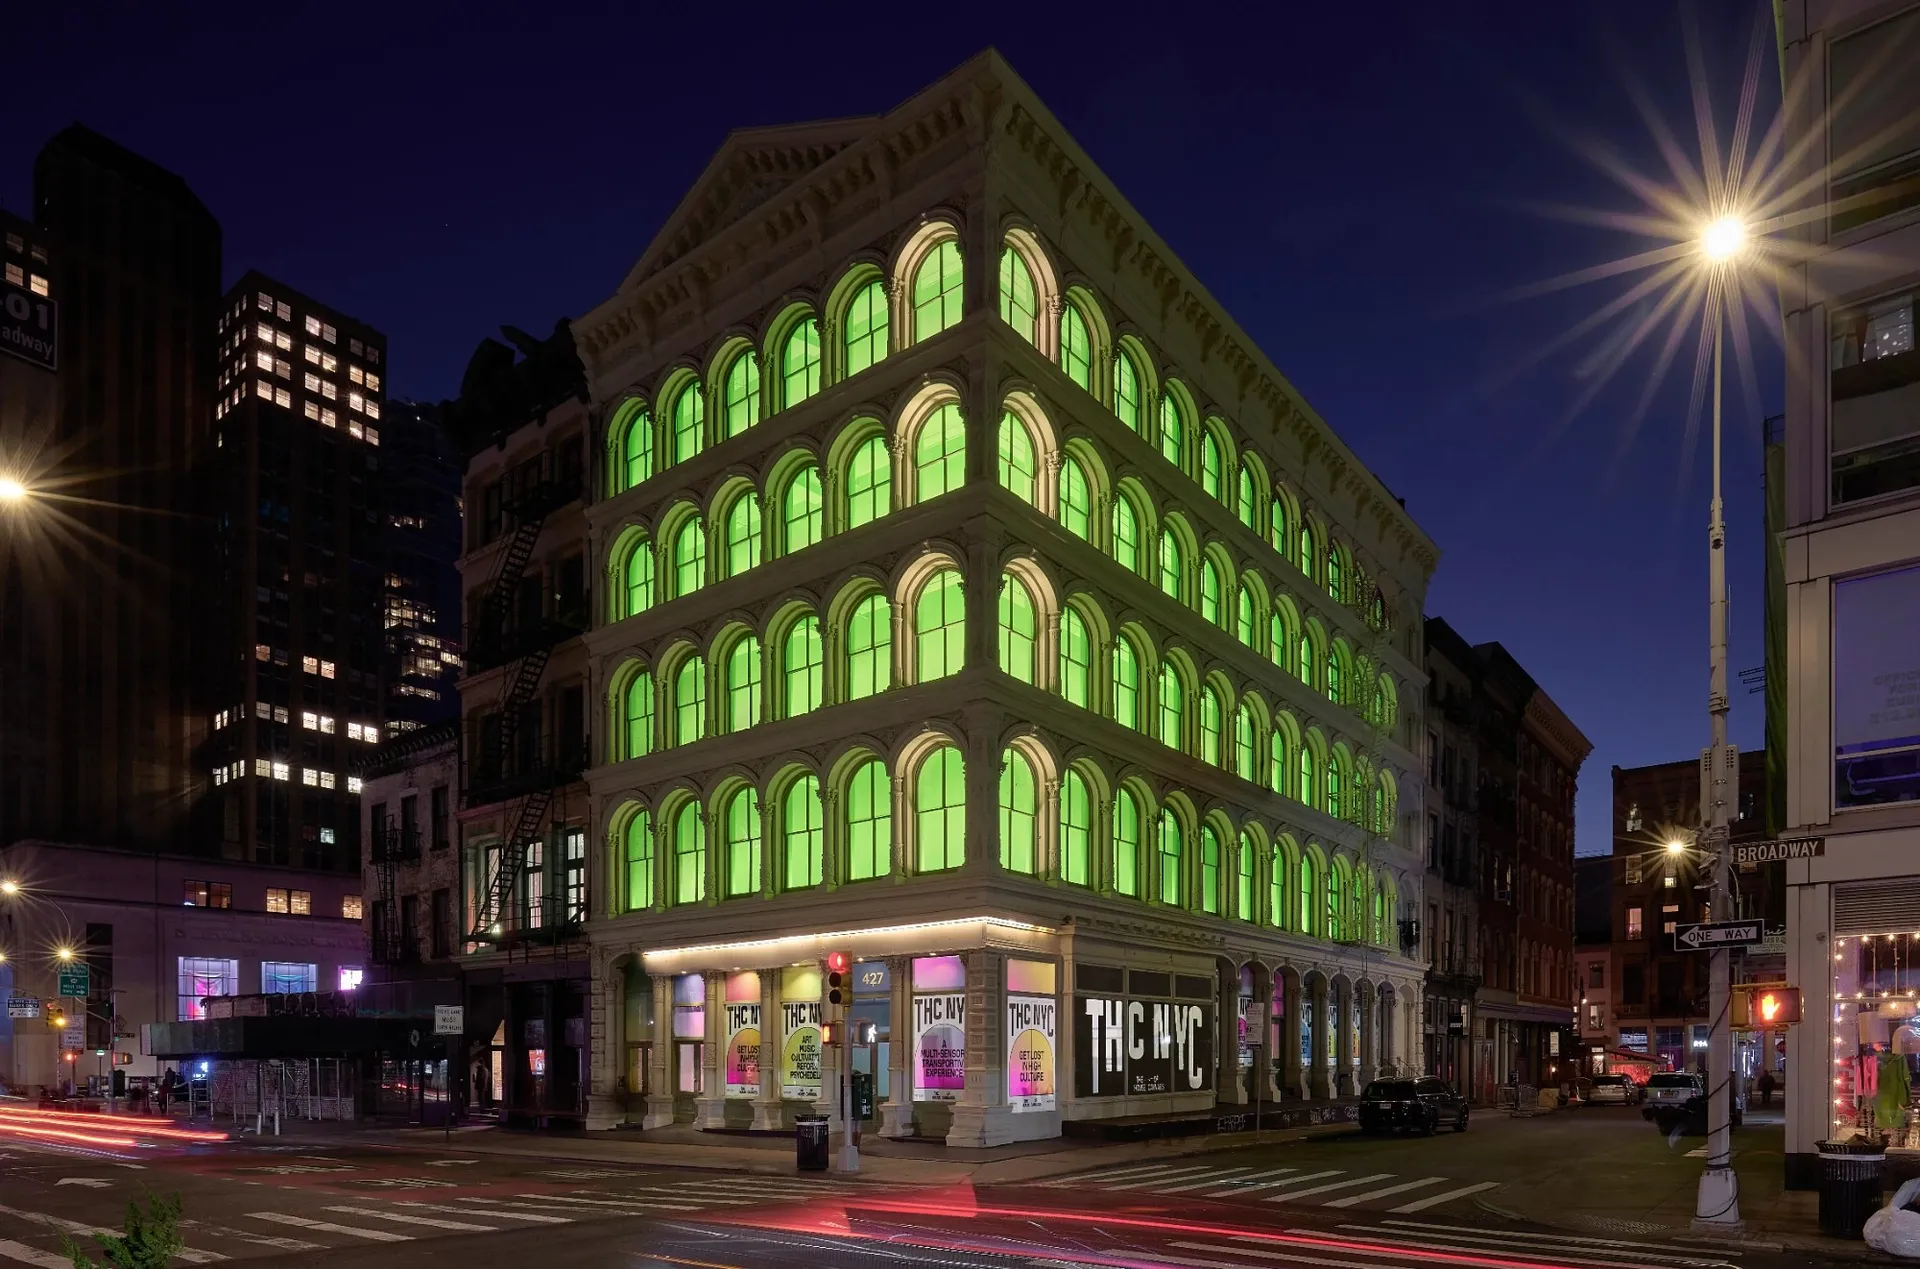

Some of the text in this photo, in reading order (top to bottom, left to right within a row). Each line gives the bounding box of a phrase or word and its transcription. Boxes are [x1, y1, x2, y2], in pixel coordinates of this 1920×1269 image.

[0, 293, 48, 330] 01
[0, 325, 53, 361] adway
[1737, 841, 1819, 862] BROADWAY
[1688, 931, 1713, 943] ONE
[1724, 928, 1751, 940] WAY
[862, 972, 884, 985] 427
[727, 1005, 760, 1035] THC N
[783, 1003, 805, 1035] THC
[914, 997, 943, 1033] THC
[1009, 1003, 1054, 1037] THC NYC
[802, 1035, 813, 1044] ART
[942, 1040, 947, 1048] A
[1085, 998, 1145, 1093] THC
[1153, 1003, 1203, 1089] NYC
[737, 1045, 747, 1054] GET
[800, 1045, 815, 1053] MUSIC
[1019, 1051, 1045, 1061] GET LOST
[926, 1069, 963, 1078] EXPERIENCE
[1020, 1072, 1044, 1082] CULTURE
